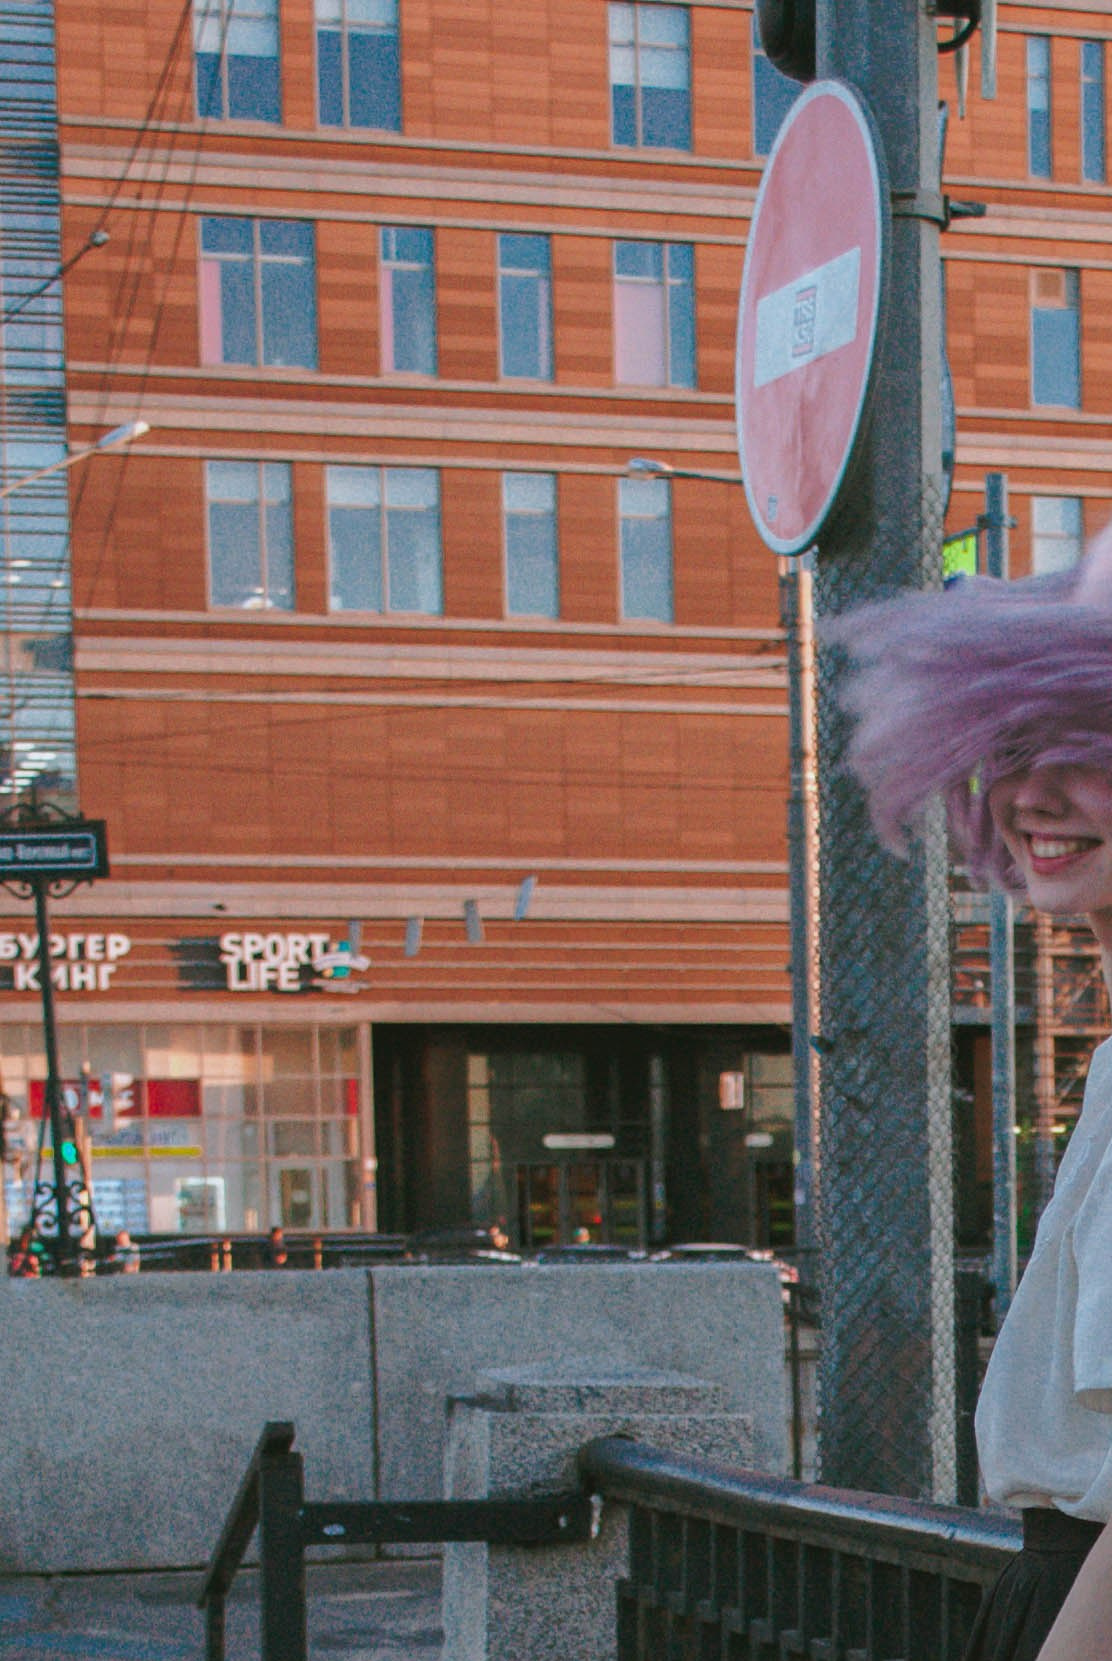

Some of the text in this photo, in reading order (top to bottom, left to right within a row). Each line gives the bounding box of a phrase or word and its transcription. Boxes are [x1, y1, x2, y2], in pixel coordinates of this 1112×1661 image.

[0, 933, 131, 960] БУРГЕР
[219, 933, 330, 964] SPORT
[14, 963, 117, 991] КИНГ
[226, 961, 301, 992] LIFE
